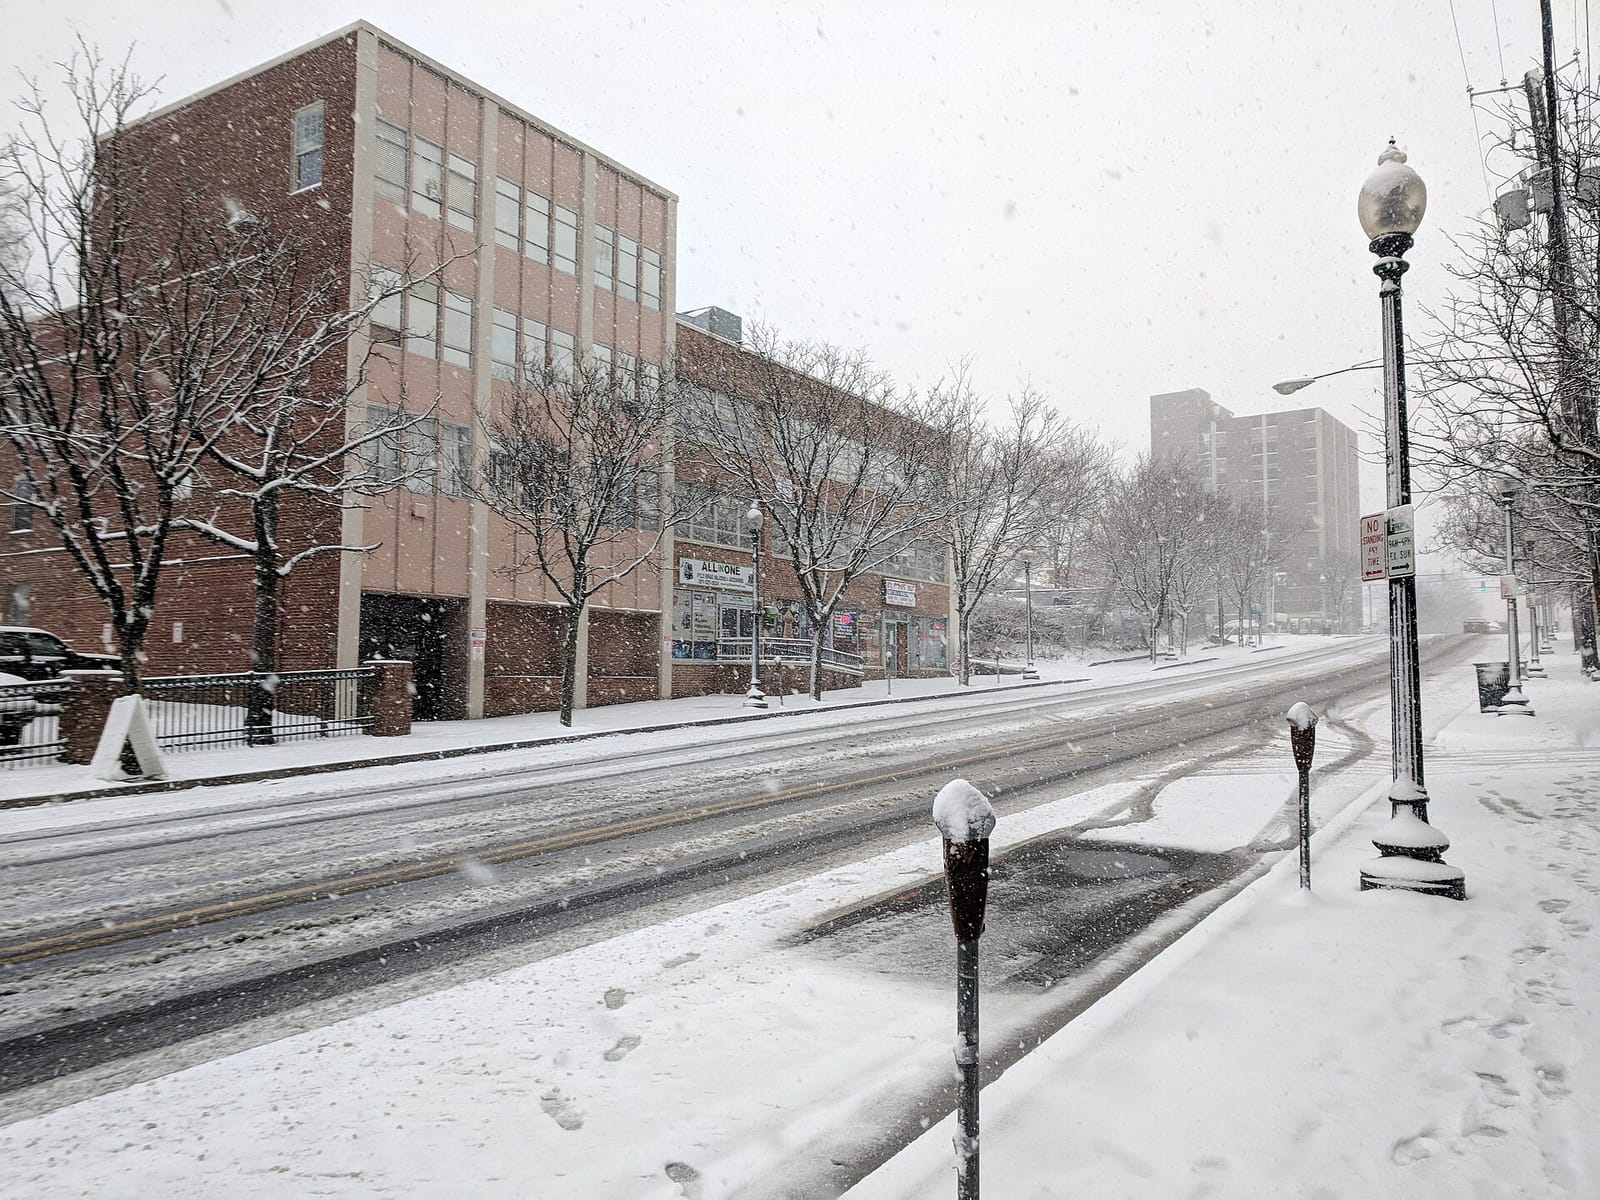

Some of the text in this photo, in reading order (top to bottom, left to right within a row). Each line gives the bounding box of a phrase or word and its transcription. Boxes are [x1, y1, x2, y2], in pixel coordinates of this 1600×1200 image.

[1367, 519, 1379, 533] NO
[1362, 533, 1384, 546] STANDING
[1368, 545, 1379, 556] ANY
[1400, 549, 1412, 560] SUN
[1367, 556, 1380, 567] TIME
